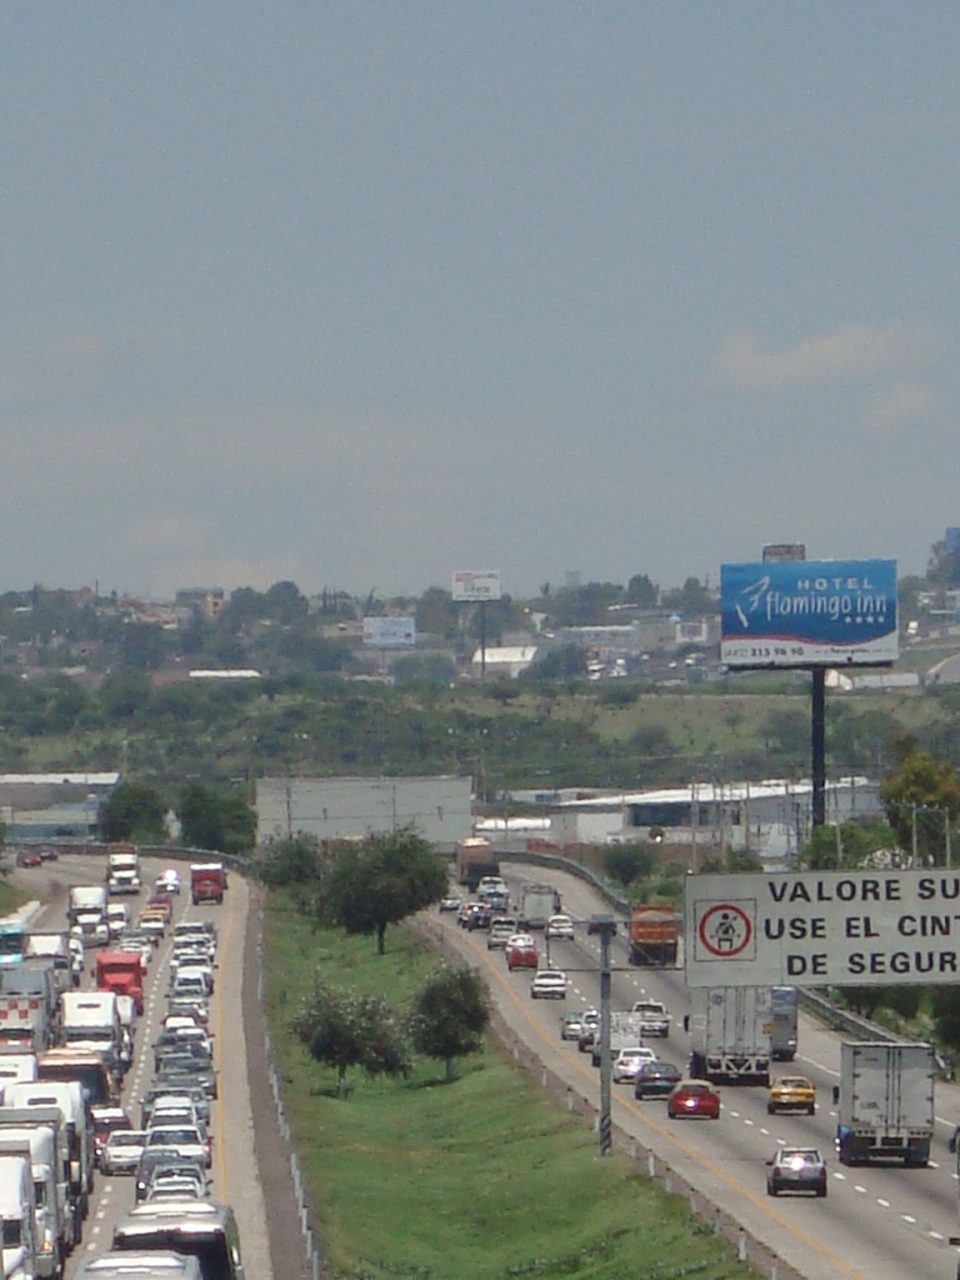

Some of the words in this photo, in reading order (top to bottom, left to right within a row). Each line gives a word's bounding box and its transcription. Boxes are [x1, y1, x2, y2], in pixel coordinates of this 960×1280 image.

[797, 577, 874, 591] HOTEL
[765, 590, 852, 621] flamingo
[856, 591, 887, 614] inn
[768, 880, 901, 902] VALORE
[918, 878, 960, 900] SU
[764, 917, 826, 940] USE
[846, 916, 880, 938] EL
[787, 953, 828, 976] DE
[848, 950, 958, 974] SEGUR
